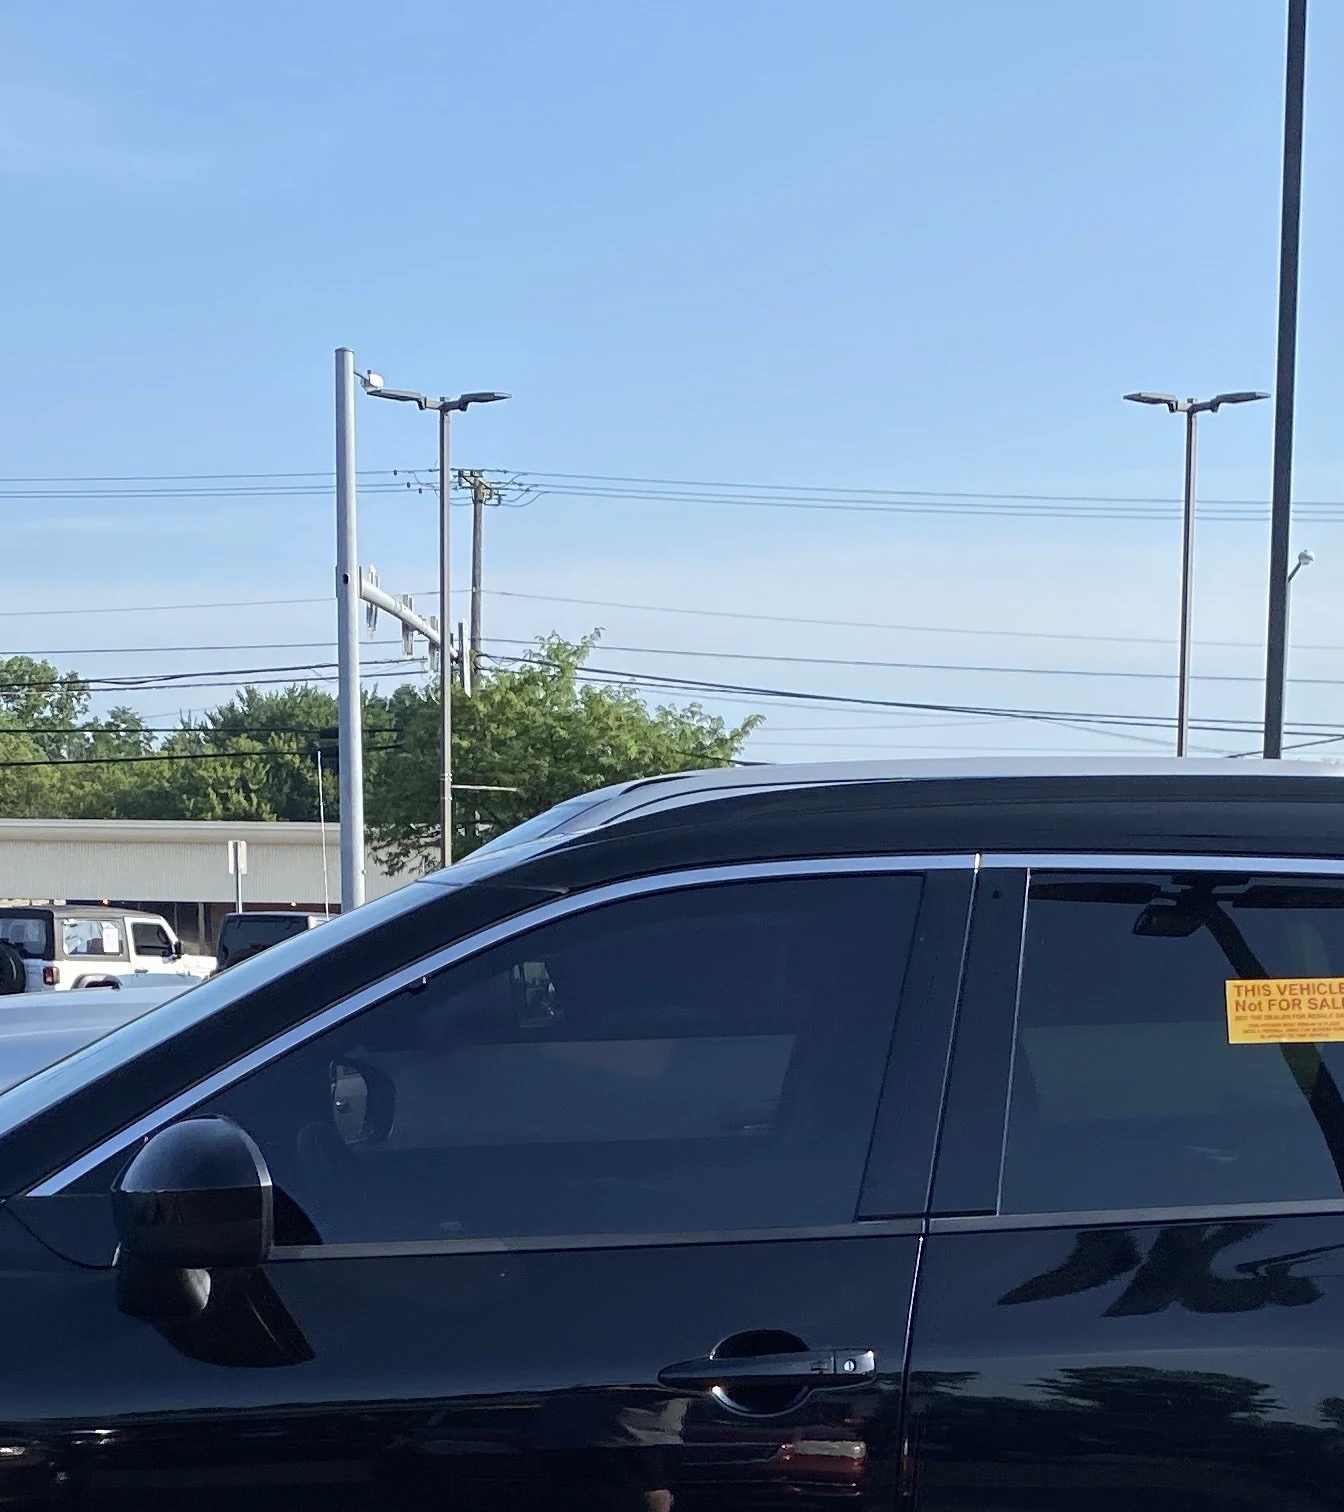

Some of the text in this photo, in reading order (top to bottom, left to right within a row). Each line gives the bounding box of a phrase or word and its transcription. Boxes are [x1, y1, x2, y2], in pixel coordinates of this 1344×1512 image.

[1233, 984, 1272, 997] THIS
[1235, 1000, 1263, 1012] Not
[1267, 998, 1303, 1011] FOR
